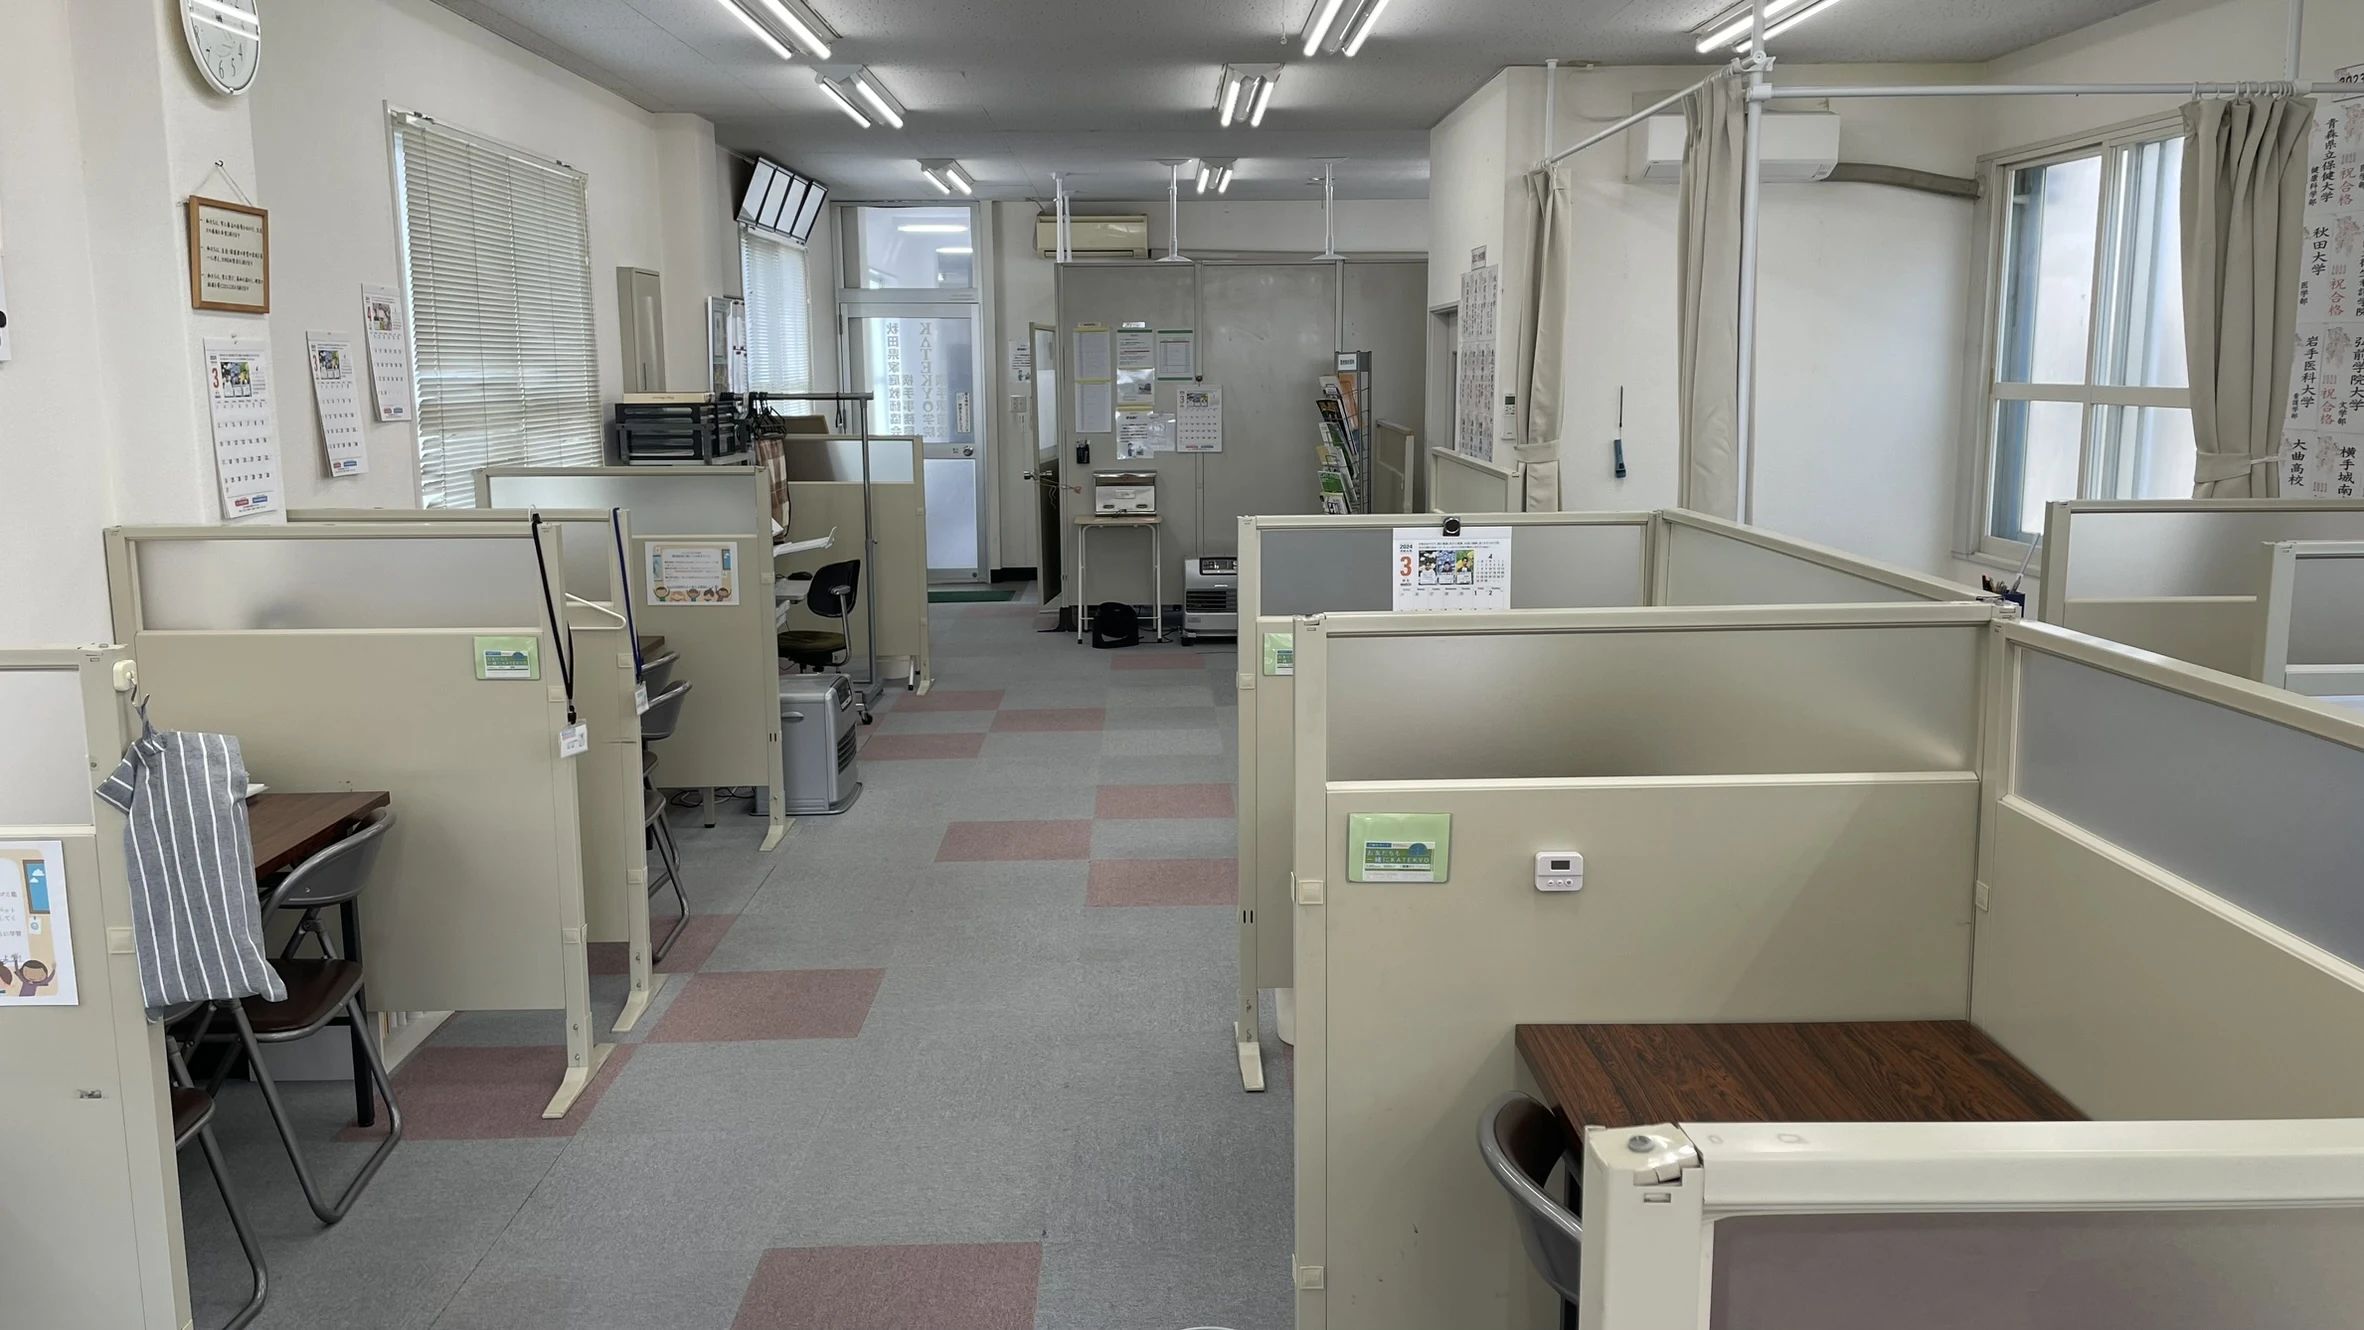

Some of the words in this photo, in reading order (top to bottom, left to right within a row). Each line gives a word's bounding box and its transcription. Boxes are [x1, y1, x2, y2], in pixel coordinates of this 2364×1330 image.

[218, 59, 225, 79] 6
[2320, 117, 2340, 203] 青森県立保健大学
[2338, 167, 2357, 206] 祝合格
[2311, 226, 2330, 276] 秋田大学
[2328, 278, 2347, 317] 祝合格
[2300, 335, 2319, 409] 岩手医科大学
[2320, 387, 2338, 425] 祝合格
[2288, 438, 2308, 487] 大曲高校
[2337, 446, 2357, 497] 横手城南
[1400, 556, 1412, 577] 3
